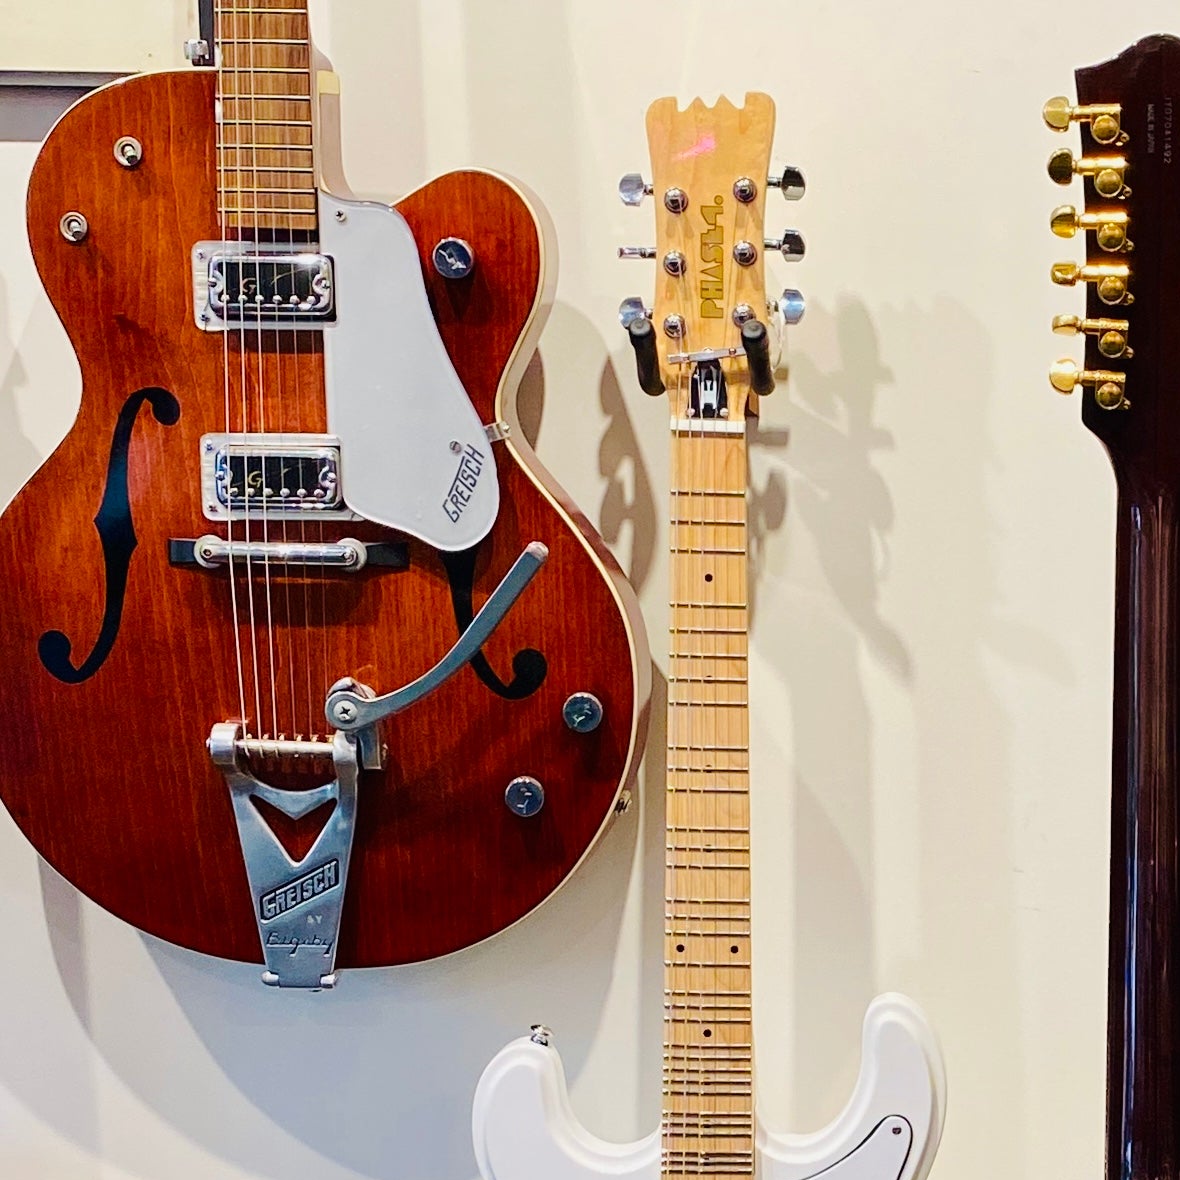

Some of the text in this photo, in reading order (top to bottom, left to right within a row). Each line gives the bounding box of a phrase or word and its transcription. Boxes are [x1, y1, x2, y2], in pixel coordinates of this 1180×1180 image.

[442, 443, 485, 524] GRETSCH
[262, 860, 338, 918] GRETSCH
[266, 931, 335, 958] Bigsby
